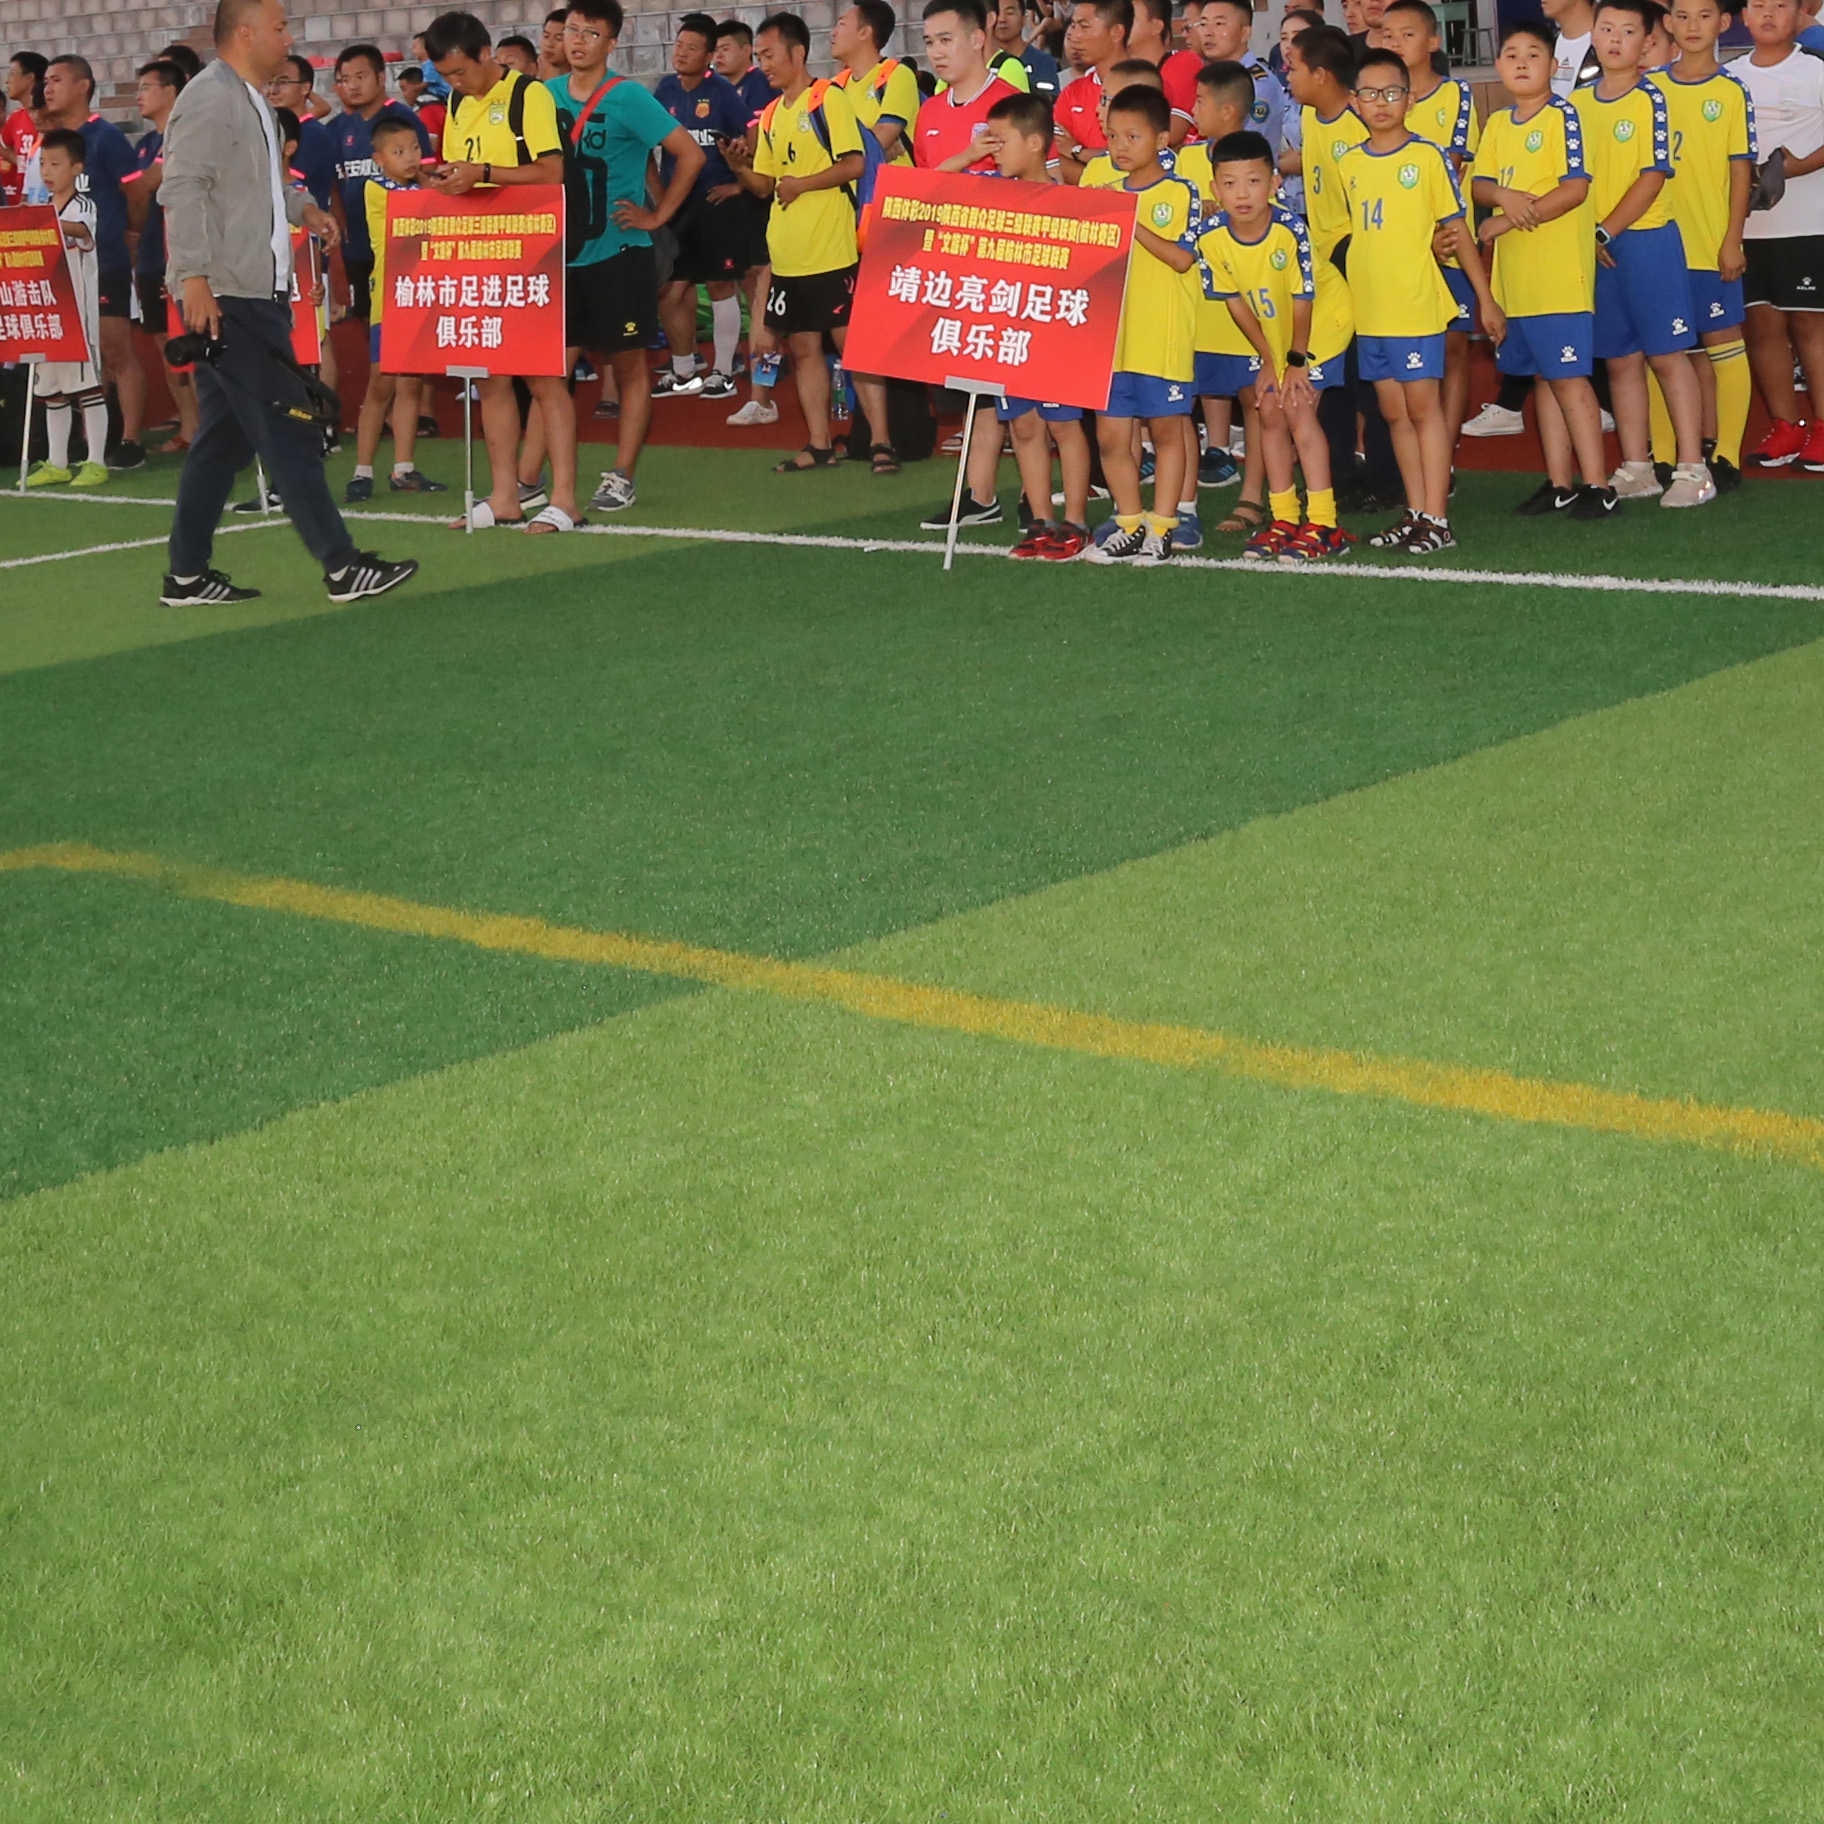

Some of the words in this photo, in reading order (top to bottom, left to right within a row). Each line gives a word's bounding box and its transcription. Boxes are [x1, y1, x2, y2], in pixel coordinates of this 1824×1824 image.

[1361, 197, 1384, 230] 14
[394, 274, 551, 308] 榆林市足进足球
[887, 264, 1090, 327] 靖边亮剑足球
[1246, 287, 1277, 319] 15
[436, 315, 504, 349] 俱乐部
[930, 316, 1032, 366] 俱乐部
